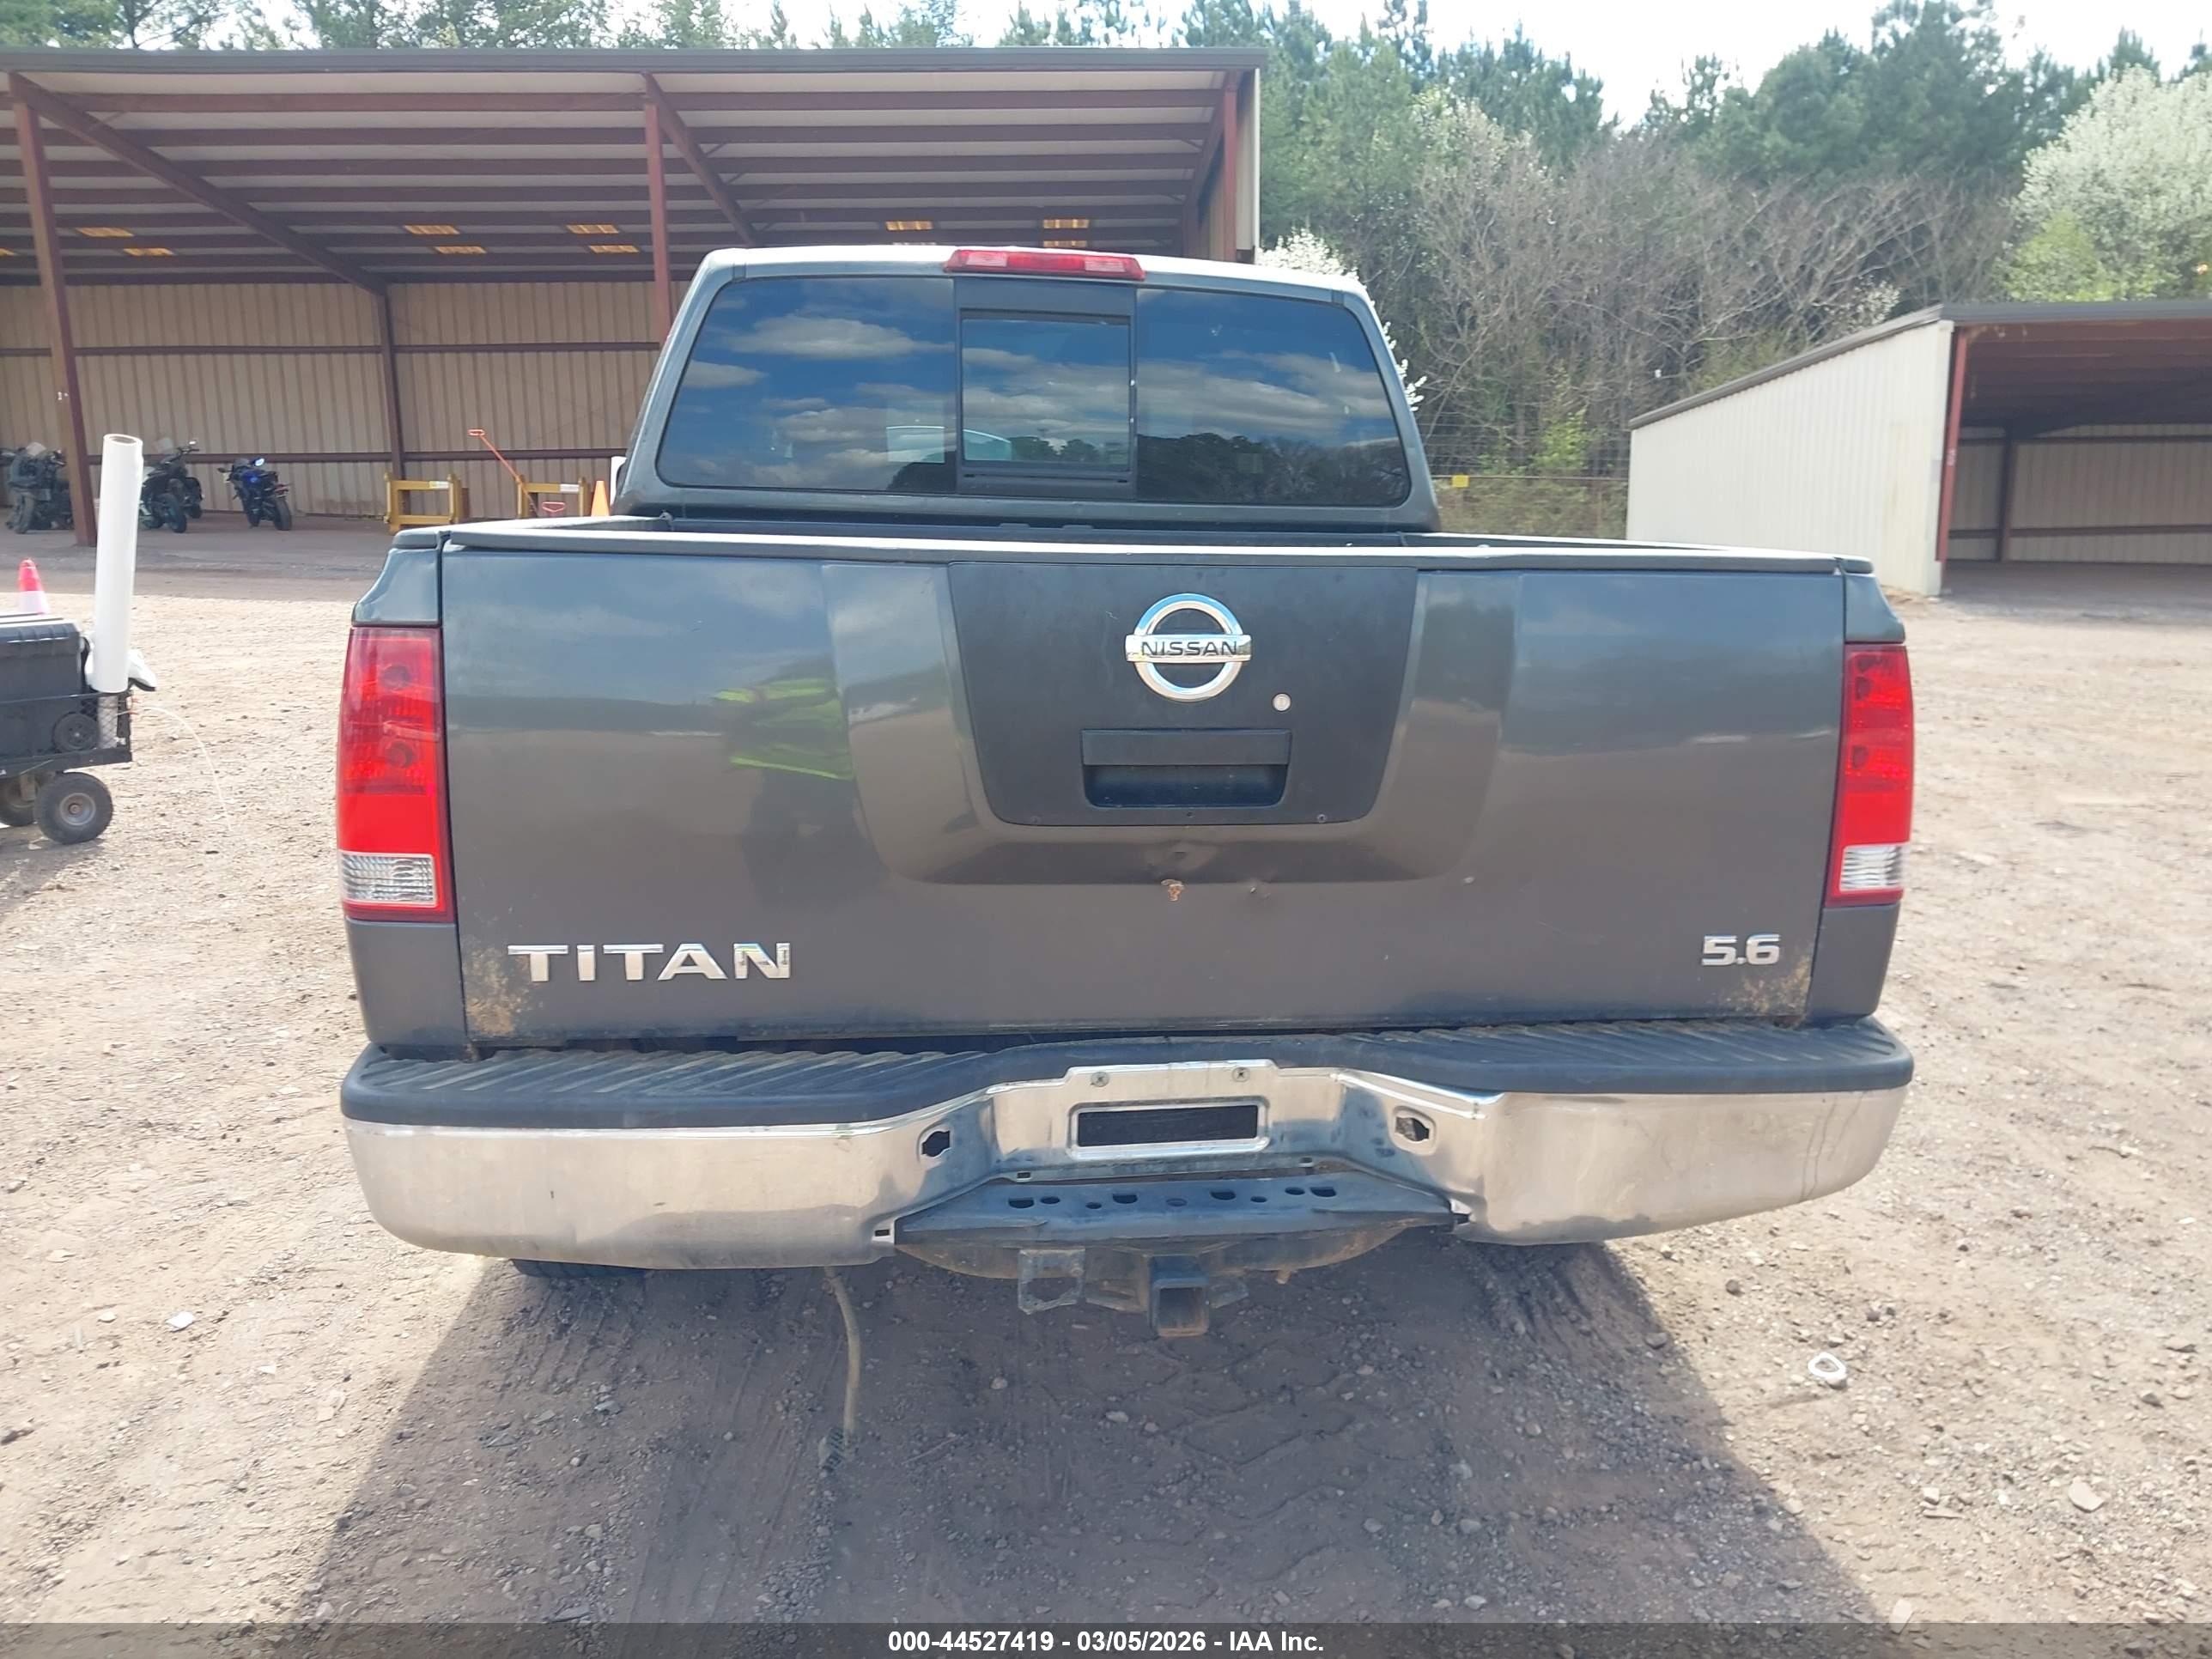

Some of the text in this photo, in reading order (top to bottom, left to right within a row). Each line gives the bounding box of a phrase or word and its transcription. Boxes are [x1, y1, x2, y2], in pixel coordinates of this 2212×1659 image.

[1141, 641, 1237, 656] NISSAN
[507, 943, 791, 981] TITAN
[1701, 933, 1781, 966] 5.6
